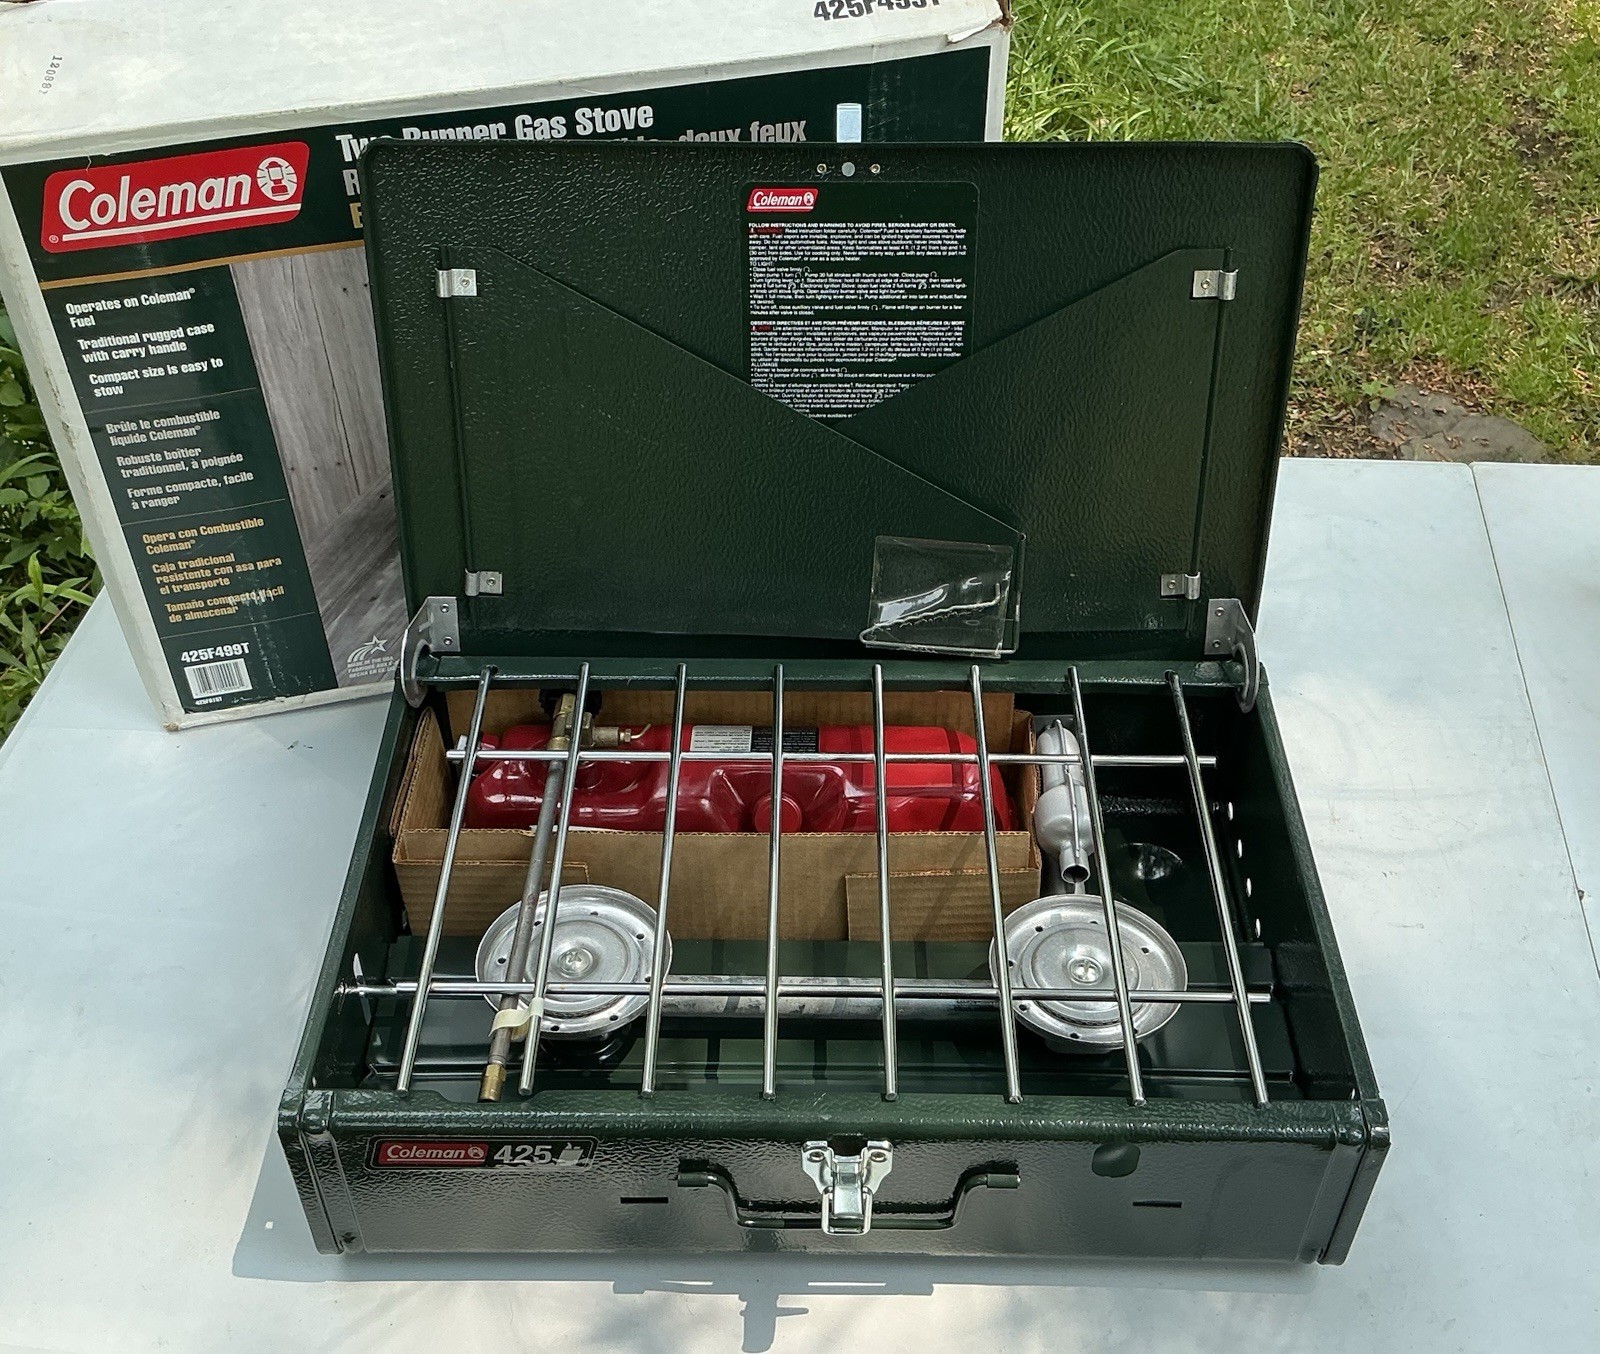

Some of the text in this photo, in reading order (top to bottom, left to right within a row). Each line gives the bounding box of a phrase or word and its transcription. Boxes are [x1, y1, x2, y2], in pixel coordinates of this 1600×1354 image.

[514, 114, 567, 140] Gas
[575, 105, 654, 136] Stove
[58, 175, 252, 231] Coleman
[753, 191, 802, 206] Coleman
[66, 299, 122, 315] Operates
[124, 297, 139, 308] on
[70, 315, 95, 328] Fuel
[77, 322, 215, 350] Traditional rugged case
[82, 341, 187, 363] with carry handle
[89, 369, 140, 385] Compact
[142, 366, 165, 378] size
[181, 361, 208, 374] easy
[210, 357, 223, 368] to
[94, 384, 124, 397] stow
[106, 410, 220, 434] Brûle le combustible
[110, 432, 147, 447] liquide
[116, 453, 162, 466] Robuste
[121, 452, 244, 478] traditionnel, à poignée
[127, 471, 254, 498] Forme compacte, facile
[141, 495, 180, 508] ranger
[142, 517, 264, 545] Opera con Combustible
[152, 552, 235, 574] Caja tradicional
[156, 557, 282, 584] resistente con asa para
[159, 576, 230, 595] el transporte
[164, 598, 204, 612] Tamaño
[168, 605, 239, 623] de almacenar
[181, 642, 250, 663] 425F499T
[387, 1144, 552, 1164] Coleman 425
